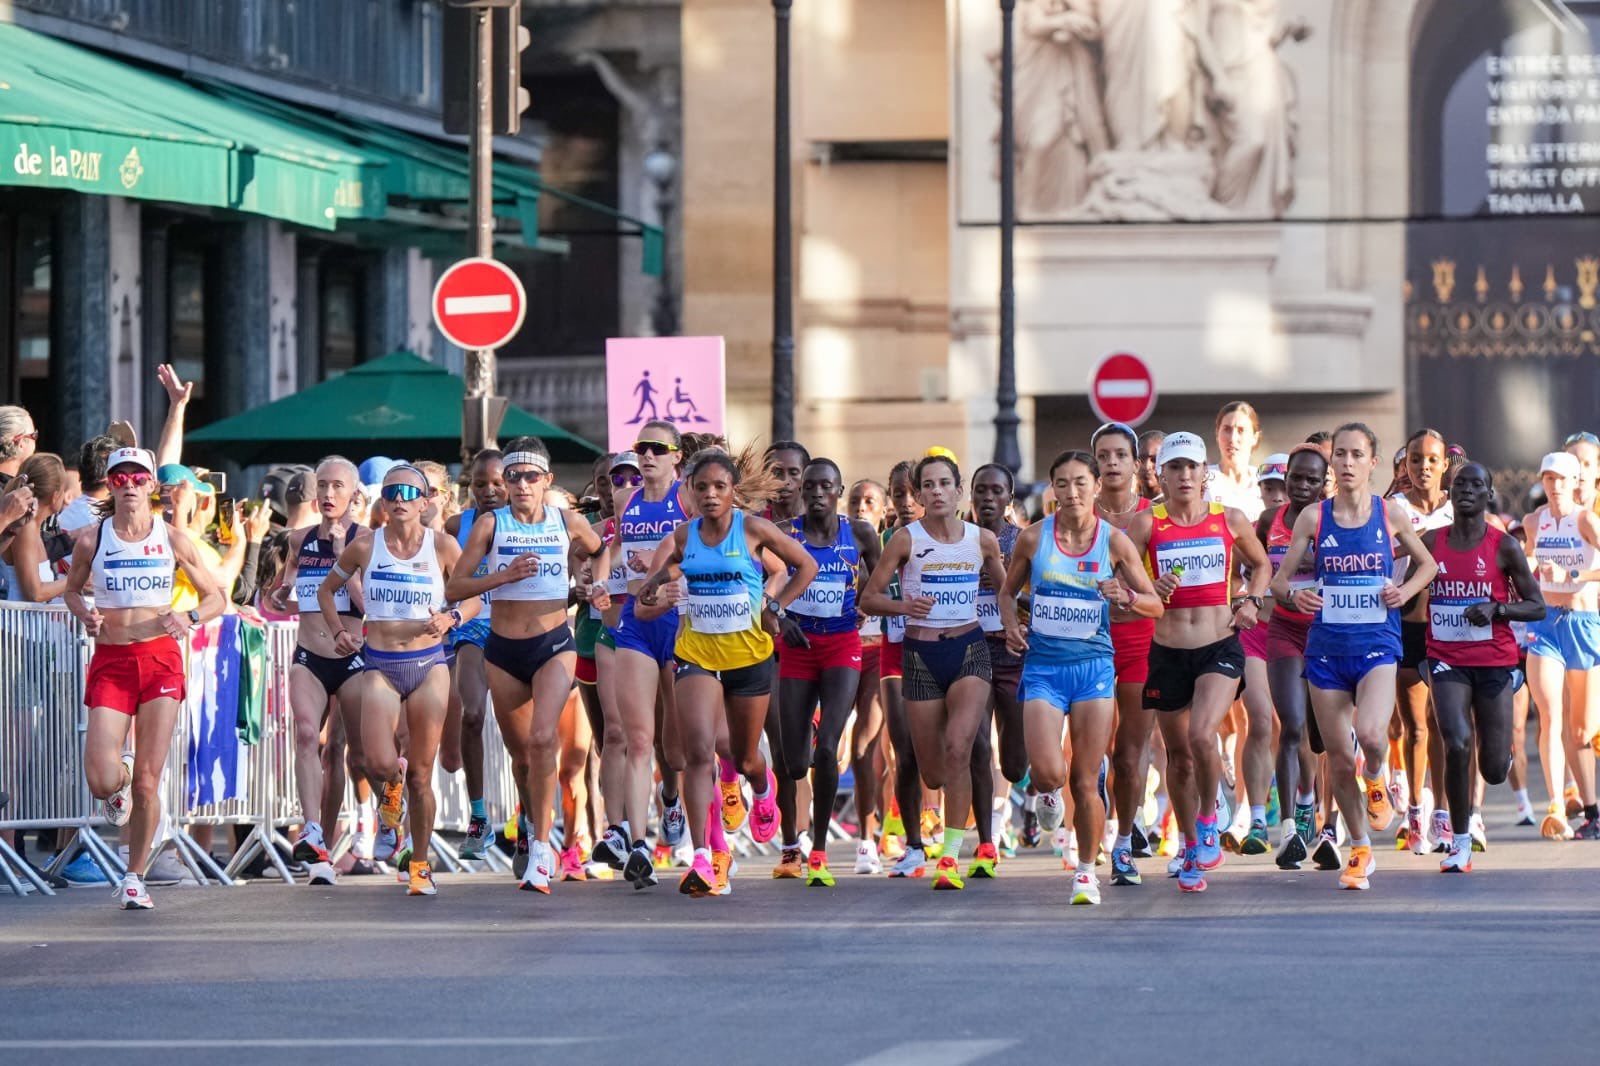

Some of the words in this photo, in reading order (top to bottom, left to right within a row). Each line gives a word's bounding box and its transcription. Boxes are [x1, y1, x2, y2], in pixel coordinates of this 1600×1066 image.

[1486, 106, 1572, 125] ENTRADA
[1574, 104, 1600, 124] PA
[14, 143, 42, 175] de
[50, 145, 68, 177] la
[70, 149, 103, 182] PAIX
[1486, 143, 1600, 163] BILLETTERI
[1487, 168, 1558, 189] TICKET
[1487, 192, 1585, 213] TAQUILLA
[506, 535, 560, 544] ARGENTINA
[497, 562, 562, 577] OPO
[818, 561, 849, 573] ANIA
[1159, 552, 1225, 572] TROFIMOVA
[1325, 553, 1384, 573] FRANCE
[106, 575, 170, 592] ELMORE
[1429, 581, 1492, 597] BAHRAIN
[370, 587, 432, 606] LINDWURM
[1331, 594, 1380, 609] JULIEN
[1034, 604, 1100, 624] GALBADRAKH
[1432, 612, 1473, 627] CHUM
